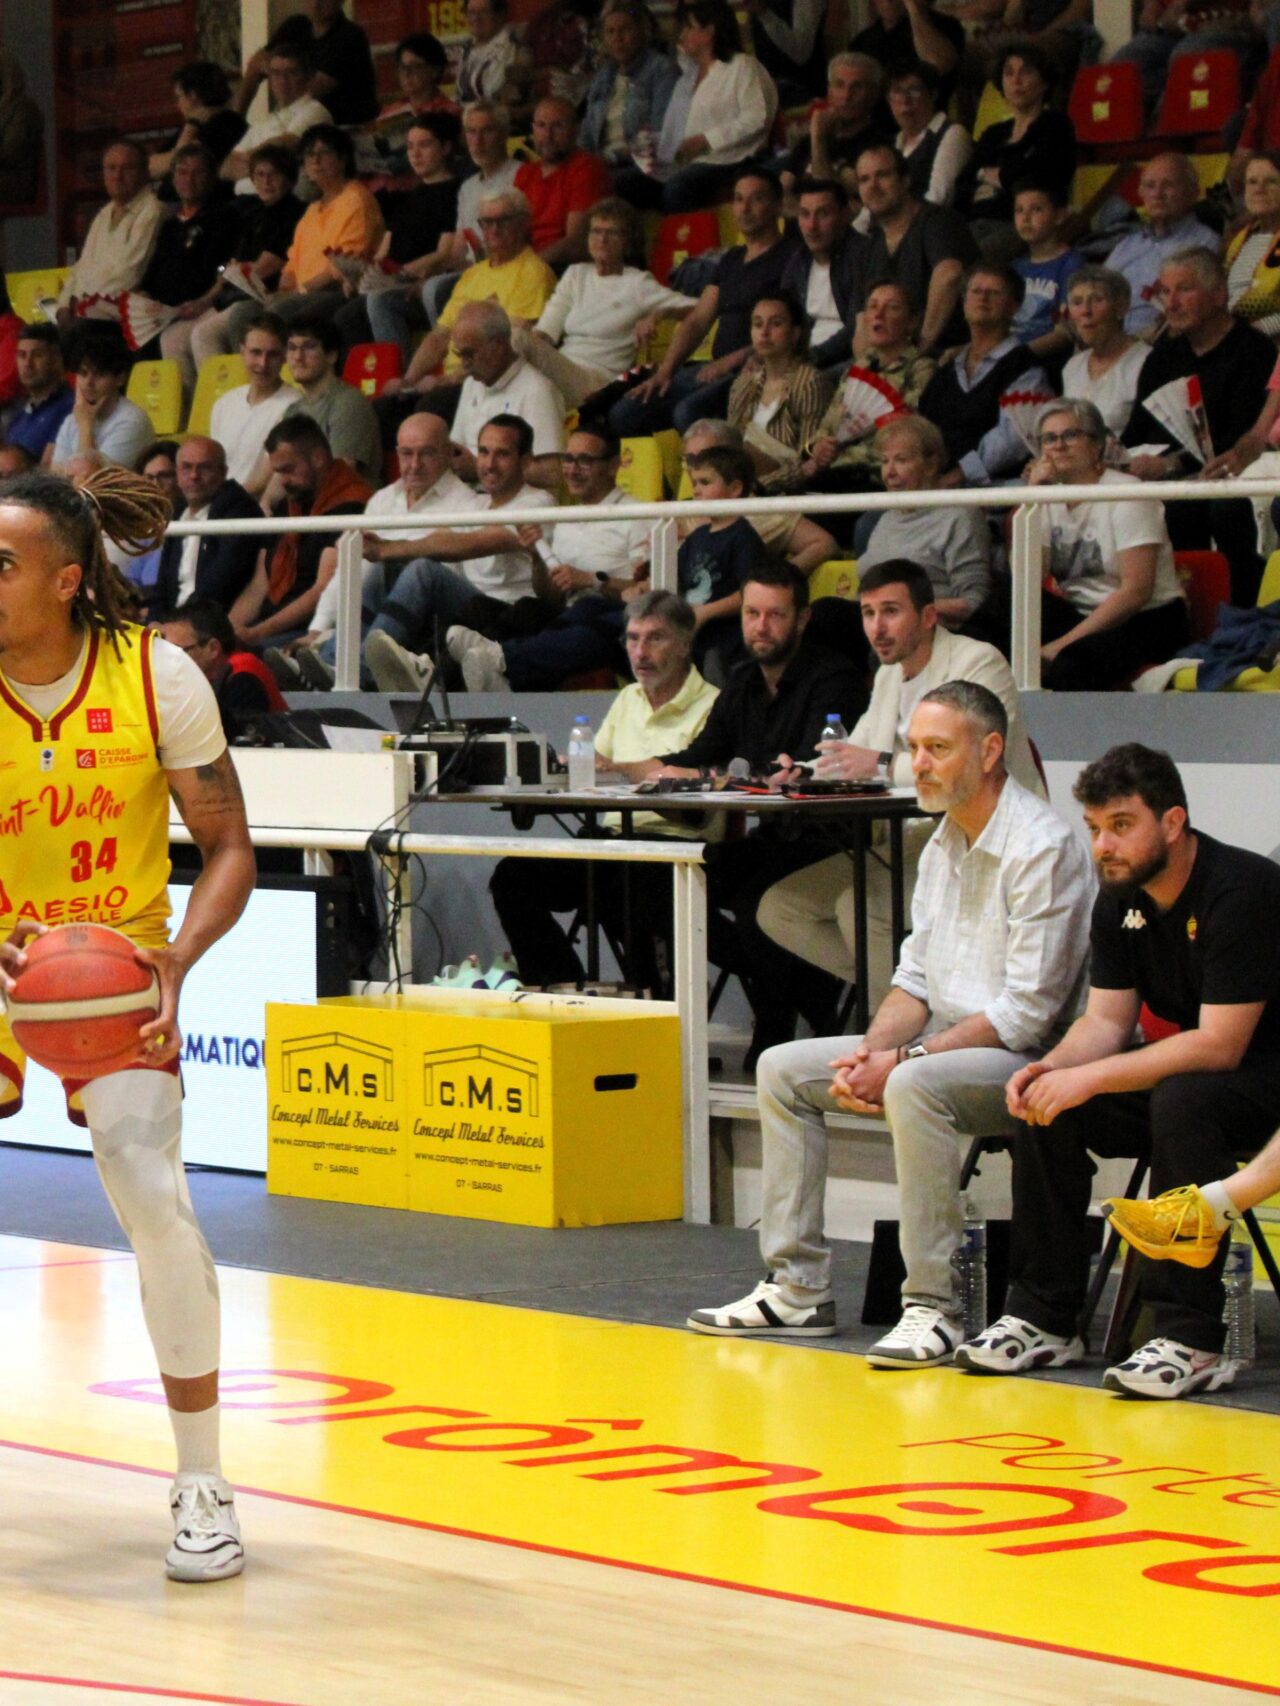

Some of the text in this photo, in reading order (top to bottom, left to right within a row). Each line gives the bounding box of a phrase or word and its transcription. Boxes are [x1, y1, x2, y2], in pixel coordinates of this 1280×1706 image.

[71, 837, 118, 883] 34
[180, 1034, 266, 1069] MATIQ
[272, 1105, 400, 1132] Concept Metal Services
[413, 1118, 545, 1149] Concept Metal Services
[272, 1136, 397, 1156] www.concept-metal-services.fr
[329, 1164, 359, 1175] SARRAS
[414, 1151, 542, 1173] www.concept-metal-services.fr
[472, 1181, 503, 1193] SARRAS
